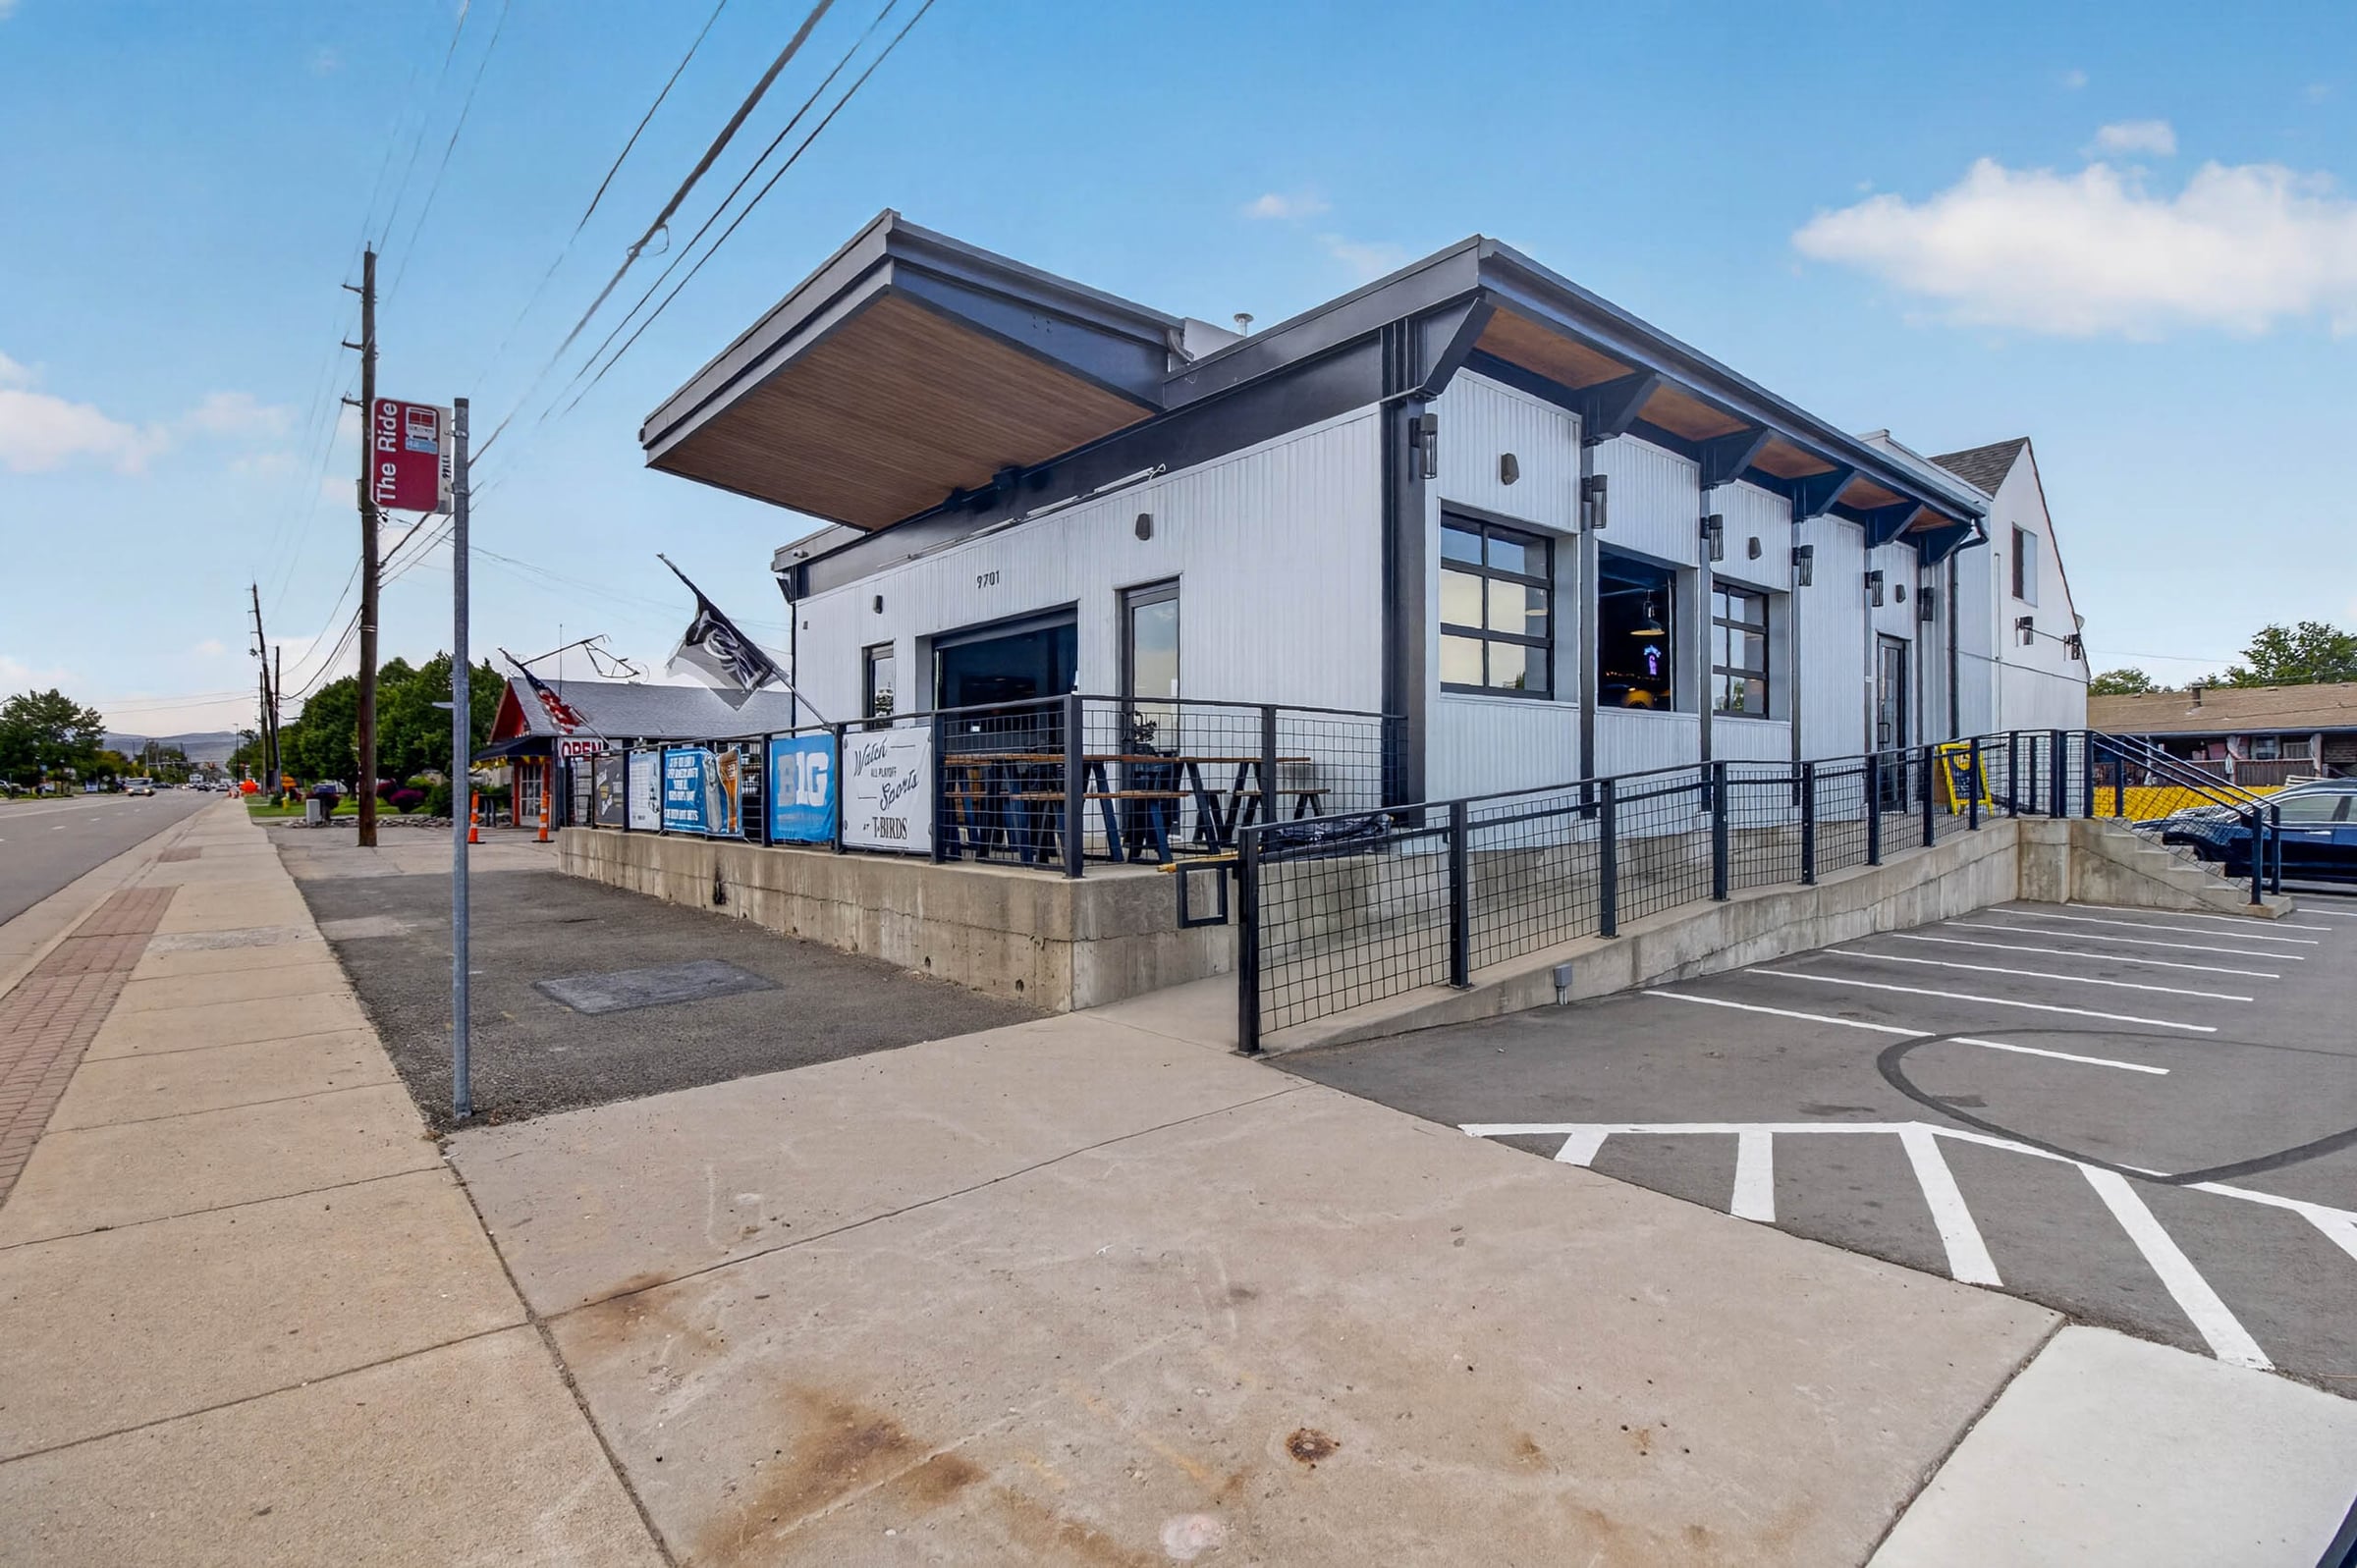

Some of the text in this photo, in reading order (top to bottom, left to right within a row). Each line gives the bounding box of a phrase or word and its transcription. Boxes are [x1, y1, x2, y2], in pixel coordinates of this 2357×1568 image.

[376, 403, 398, 503] The Ride
[976, 569, 1000, 589] 9701
[561, 741, 602, 762] OPEN
[853, 736, 888, 777] Watch
[880, 769, 919, 811] Sports
